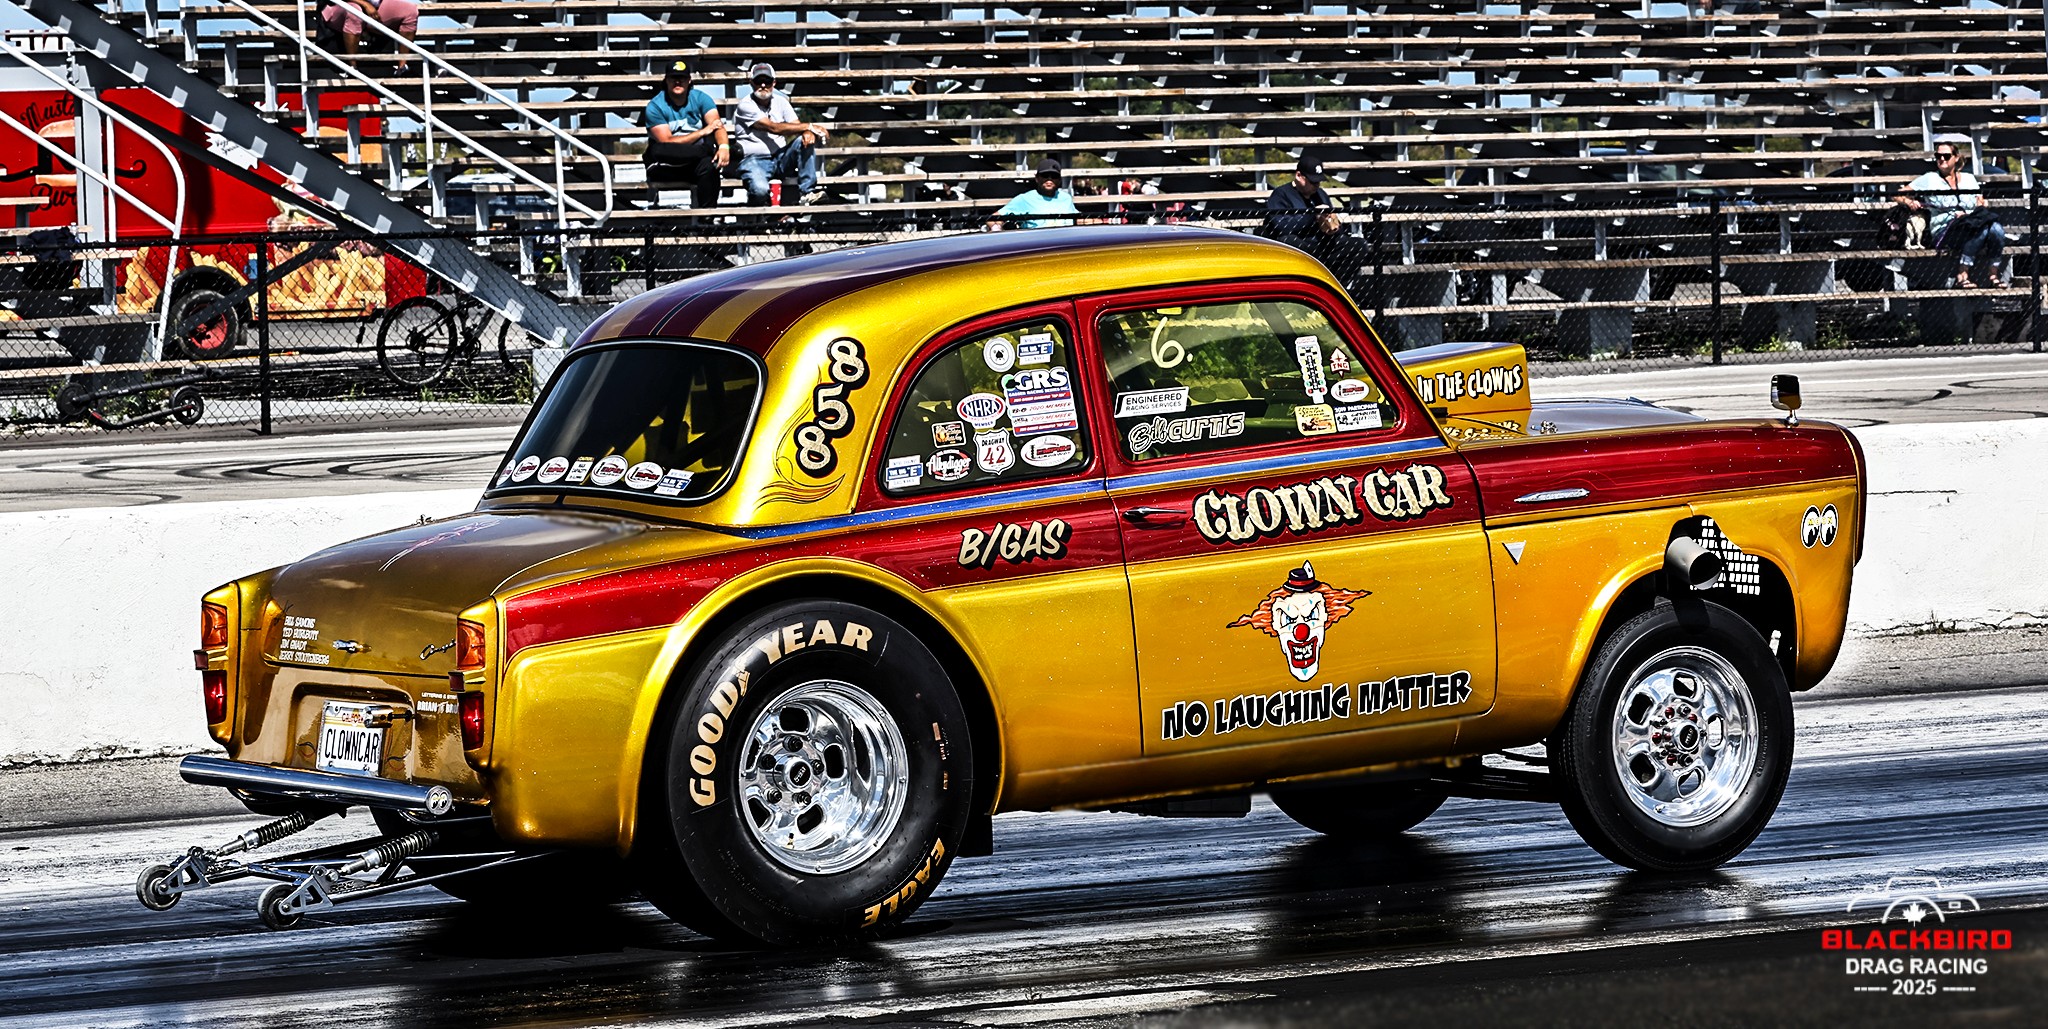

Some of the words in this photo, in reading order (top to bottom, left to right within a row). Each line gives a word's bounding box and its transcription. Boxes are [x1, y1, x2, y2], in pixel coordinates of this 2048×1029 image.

[1332, 362, 1348, 370] TNG
[1417, 375, 1436, 404] IN
[1435, 371, 1466, 402] THE
[1467, 364, 1524, 399] CLOWNS
[793, 336, 870, 478] 858
[965, 399, 1000, 418] NHRA
[1125, 403, 1150, 412] RACING
[1151, 401, 1182, 409] SERVICES
[1126, 392, 1182, 406] ENGINEERED
[1045, 412, 1073, 420] MEMBER
[981, 438, 1005, 447] DRAGWAY
[983, 445, 1006, 465] 42
[1192, 473, 1365, 544] CLOWN
[1362, 463, 1455, 520] CAR
[958, 518, 1072, 570] B/GAS
[417, 700, 438, 713] BRIAN
[1161, 700, 1209, 743] NO
[1213, 684, 1351, 736] LAUGHING
[1357, 671, 1474, 715] MATTER
[324, 728, 380, 764] CLOWNCAR
[860, 836, 945, 930] EAGLE
